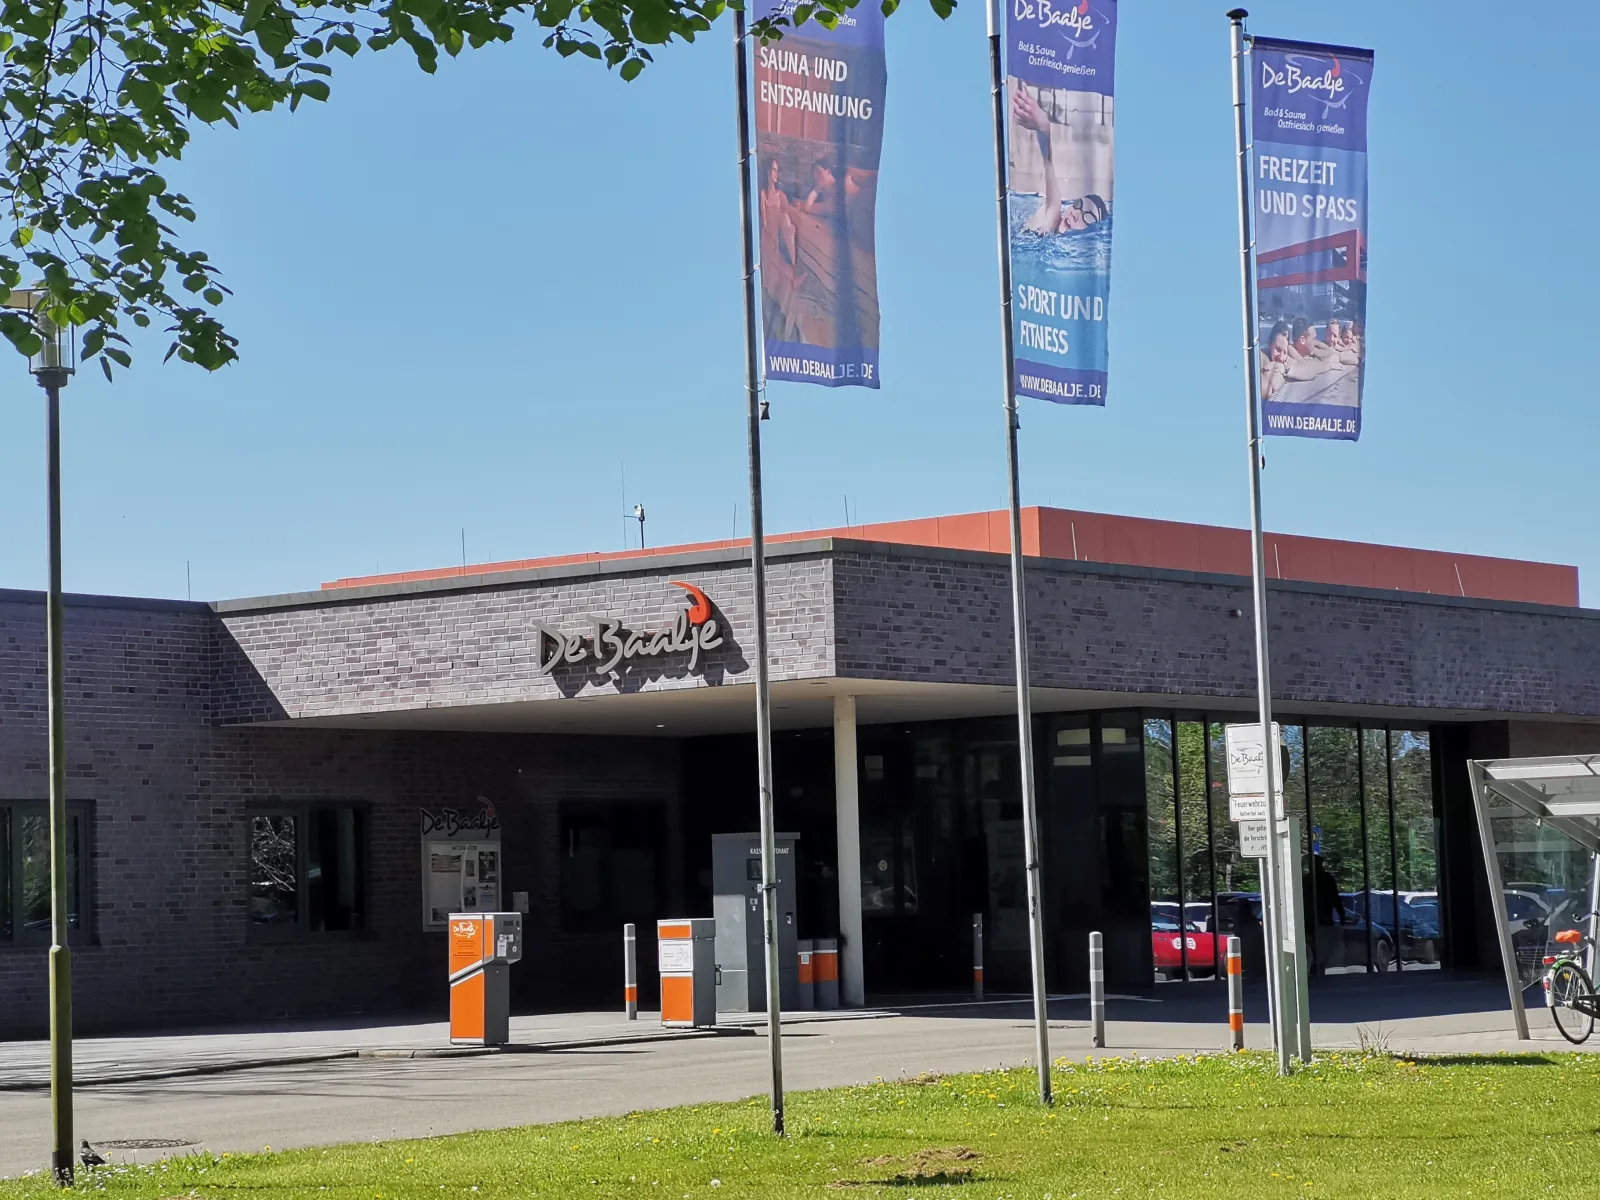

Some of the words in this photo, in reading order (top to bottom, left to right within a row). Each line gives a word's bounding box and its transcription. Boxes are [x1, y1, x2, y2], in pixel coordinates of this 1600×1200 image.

[1036, 0, 1093, 37] Baalje
[760, 46, 809, 76] SAUNA
[814, 57, 848, 82] UND
[1035, 45, 1056, 57] Sauna
[1062, 63, 1096, 76] genießen
[1262, 61, 1285, 89] De
[1285, 63, 1345, 98] Baalje
[760, 80, 873, 120] ENTSPANNUNG
[1264, 107, 1279, 118] Bad
[1278, 108, 1284, 118] &
[1284, 108, 1306, 120] Sauna
[1277, 119, 1315, 132] Ostfriesisch
[1316, 123, 1345, 135] genießen
[1259, 155, 1337, 186] FREIZEIT
[1260, 189, 1297, 216] UND
[1302, 194, 1357, 223] SPASS
[1018, 284, 1057, 316] SPORT
[1060, 294, 1103, 321] UND
[1020, 320, 1069, 355] FITNESS
[769, 356, 873, 379] WWW.DEBAALJE.DE
[1020, 374, 1101, 398] WWW.DEBAALJE.DE
[1268, 415, 1355, 433] WWW.DEBAALJE.DE
[532, 619, 587, 675] De
[586, 606, 723, 675] Baalje
[1241, 750, 1263, 766] Baalj
[421, 807, 444, 836] De
[443, 808, 500, 838] Baalje
